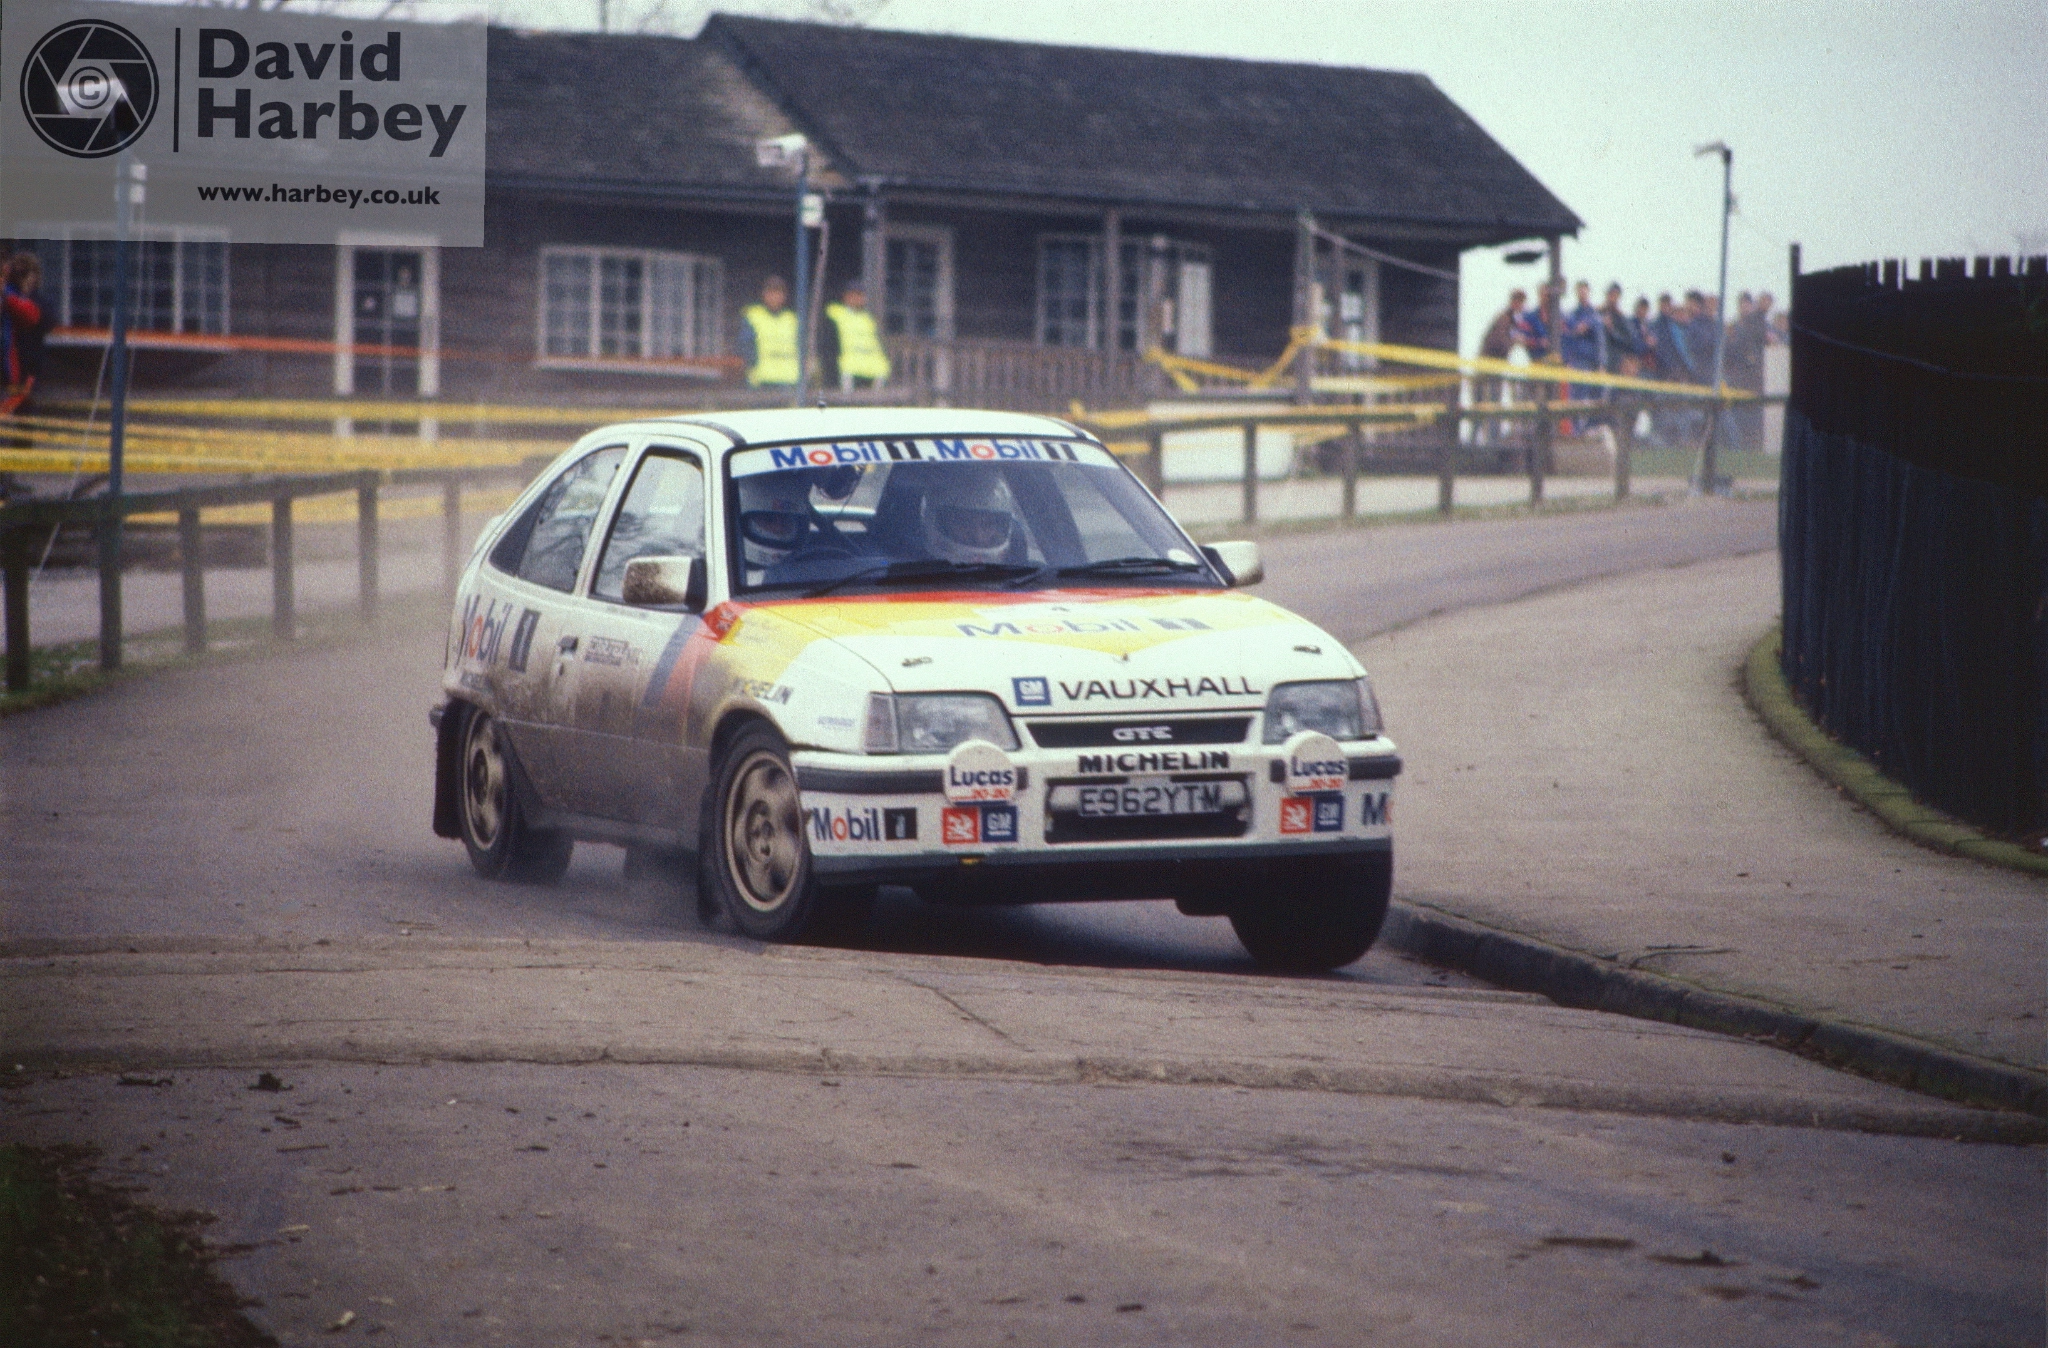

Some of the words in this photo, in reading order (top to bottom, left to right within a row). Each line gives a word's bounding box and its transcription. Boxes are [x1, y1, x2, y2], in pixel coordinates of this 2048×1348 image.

[770, 443, 881, 469] Mobil
[932, 439, 1041, 460] Mobil
[955, 618, 1142, 637] Mobil
[1059, 676, 1262, 701] VAUXHALL
[1112, 726, 1173, 741] GTE
[1078, 751, 1229, 773] MICHELIN
[1291, 756, 1346, 776] Lucas
[951, 765, 1013, 786] Lucas
[813, 808, 880, 841] Mobil
